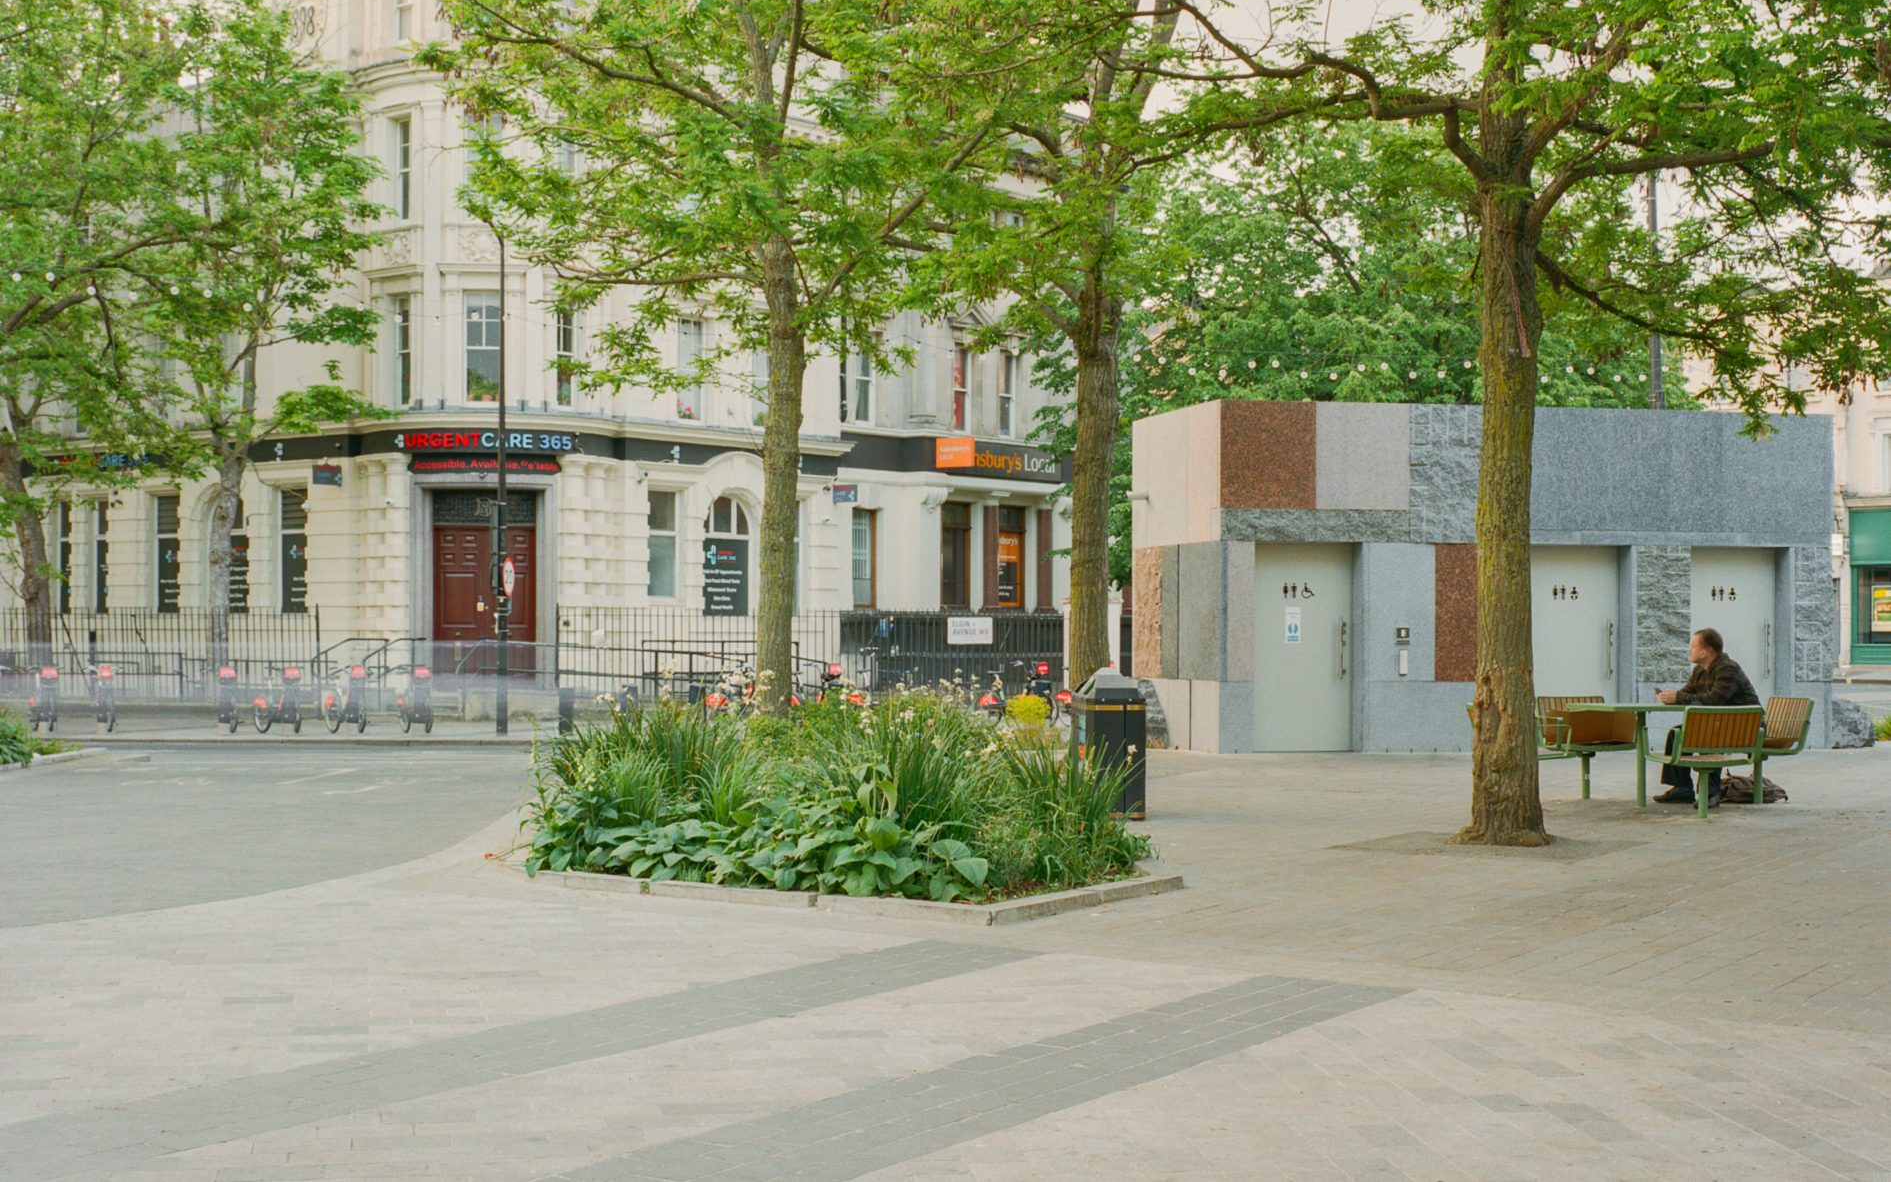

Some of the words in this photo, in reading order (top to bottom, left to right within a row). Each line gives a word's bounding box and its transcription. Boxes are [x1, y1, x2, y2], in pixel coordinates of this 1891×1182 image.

[539, 434, 572, 450] 365
[470, 459, 519, 470] Availle.
[974, 449, 1023, 474] nsbury's
[951, 620, 970, 628] ELGIN
[952, 628, 977, 636] AVENUE
